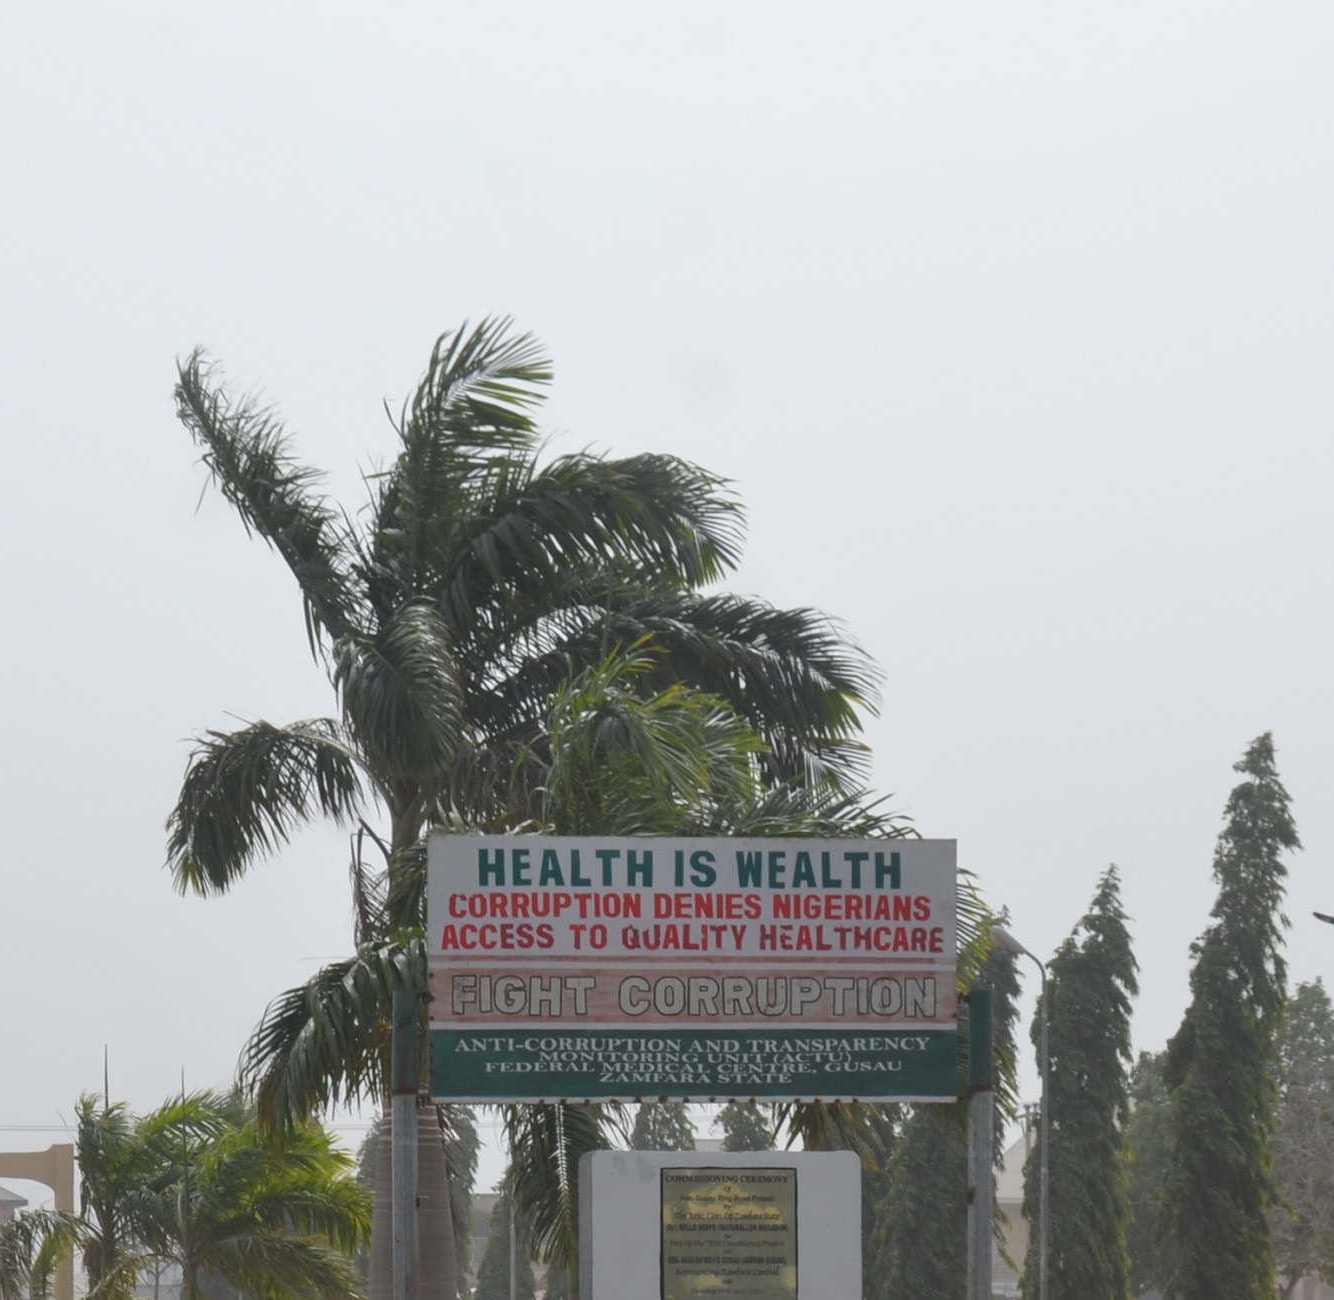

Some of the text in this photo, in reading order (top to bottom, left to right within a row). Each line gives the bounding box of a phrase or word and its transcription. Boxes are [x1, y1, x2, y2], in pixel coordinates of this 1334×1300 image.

[478, 848, 901, 889] HEALTH IS WEALTH
[448, 892, 931, 922] CORRUPTION DENIES NIGERIANS
[441, 923, 944, 953] ACCESS TO QUALITY HEALTHCARE
[451, 974, 937, 1018] FIGHT CORRUPTION
[455, 1037, 930, 1053] ANTI-CORRUPTION AND TRANSPARENCY
[539, 1051, 852, 1064] MONITORING UNIT (ACTU)
[485, 1060, 902, 1074] FEDERAL MEDICAL CENTRE, GUSAU
[599, 1071, 793, 1084] ZAMFARA STATE
[665, 1175, 788, 1183] COMMISSIONING CEREMONY
